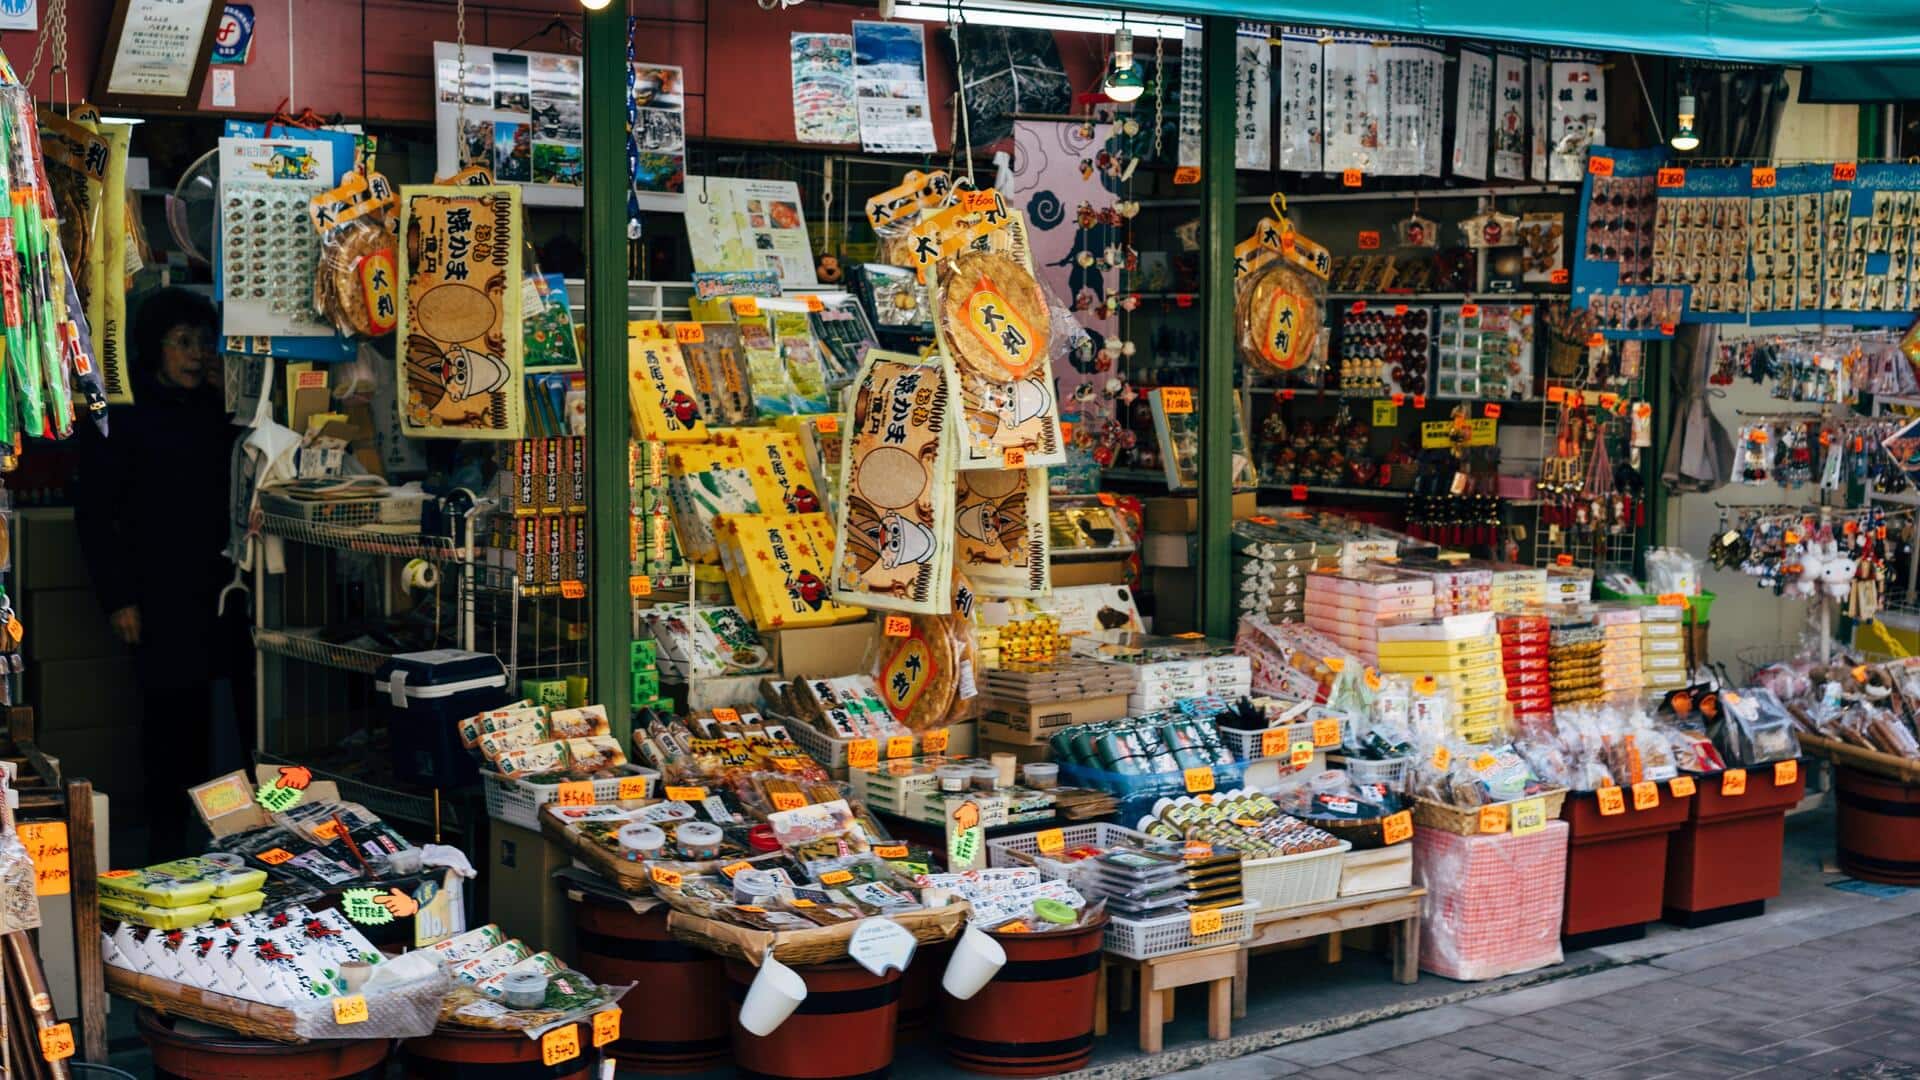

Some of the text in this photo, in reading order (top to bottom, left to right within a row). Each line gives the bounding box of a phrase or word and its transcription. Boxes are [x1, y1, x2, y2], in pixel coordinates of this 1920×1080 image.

[967, 194, 994, 210] ¥600
[1273, 307, 1294, 354] 大判
[563, 789, 593, 806] ¥540
